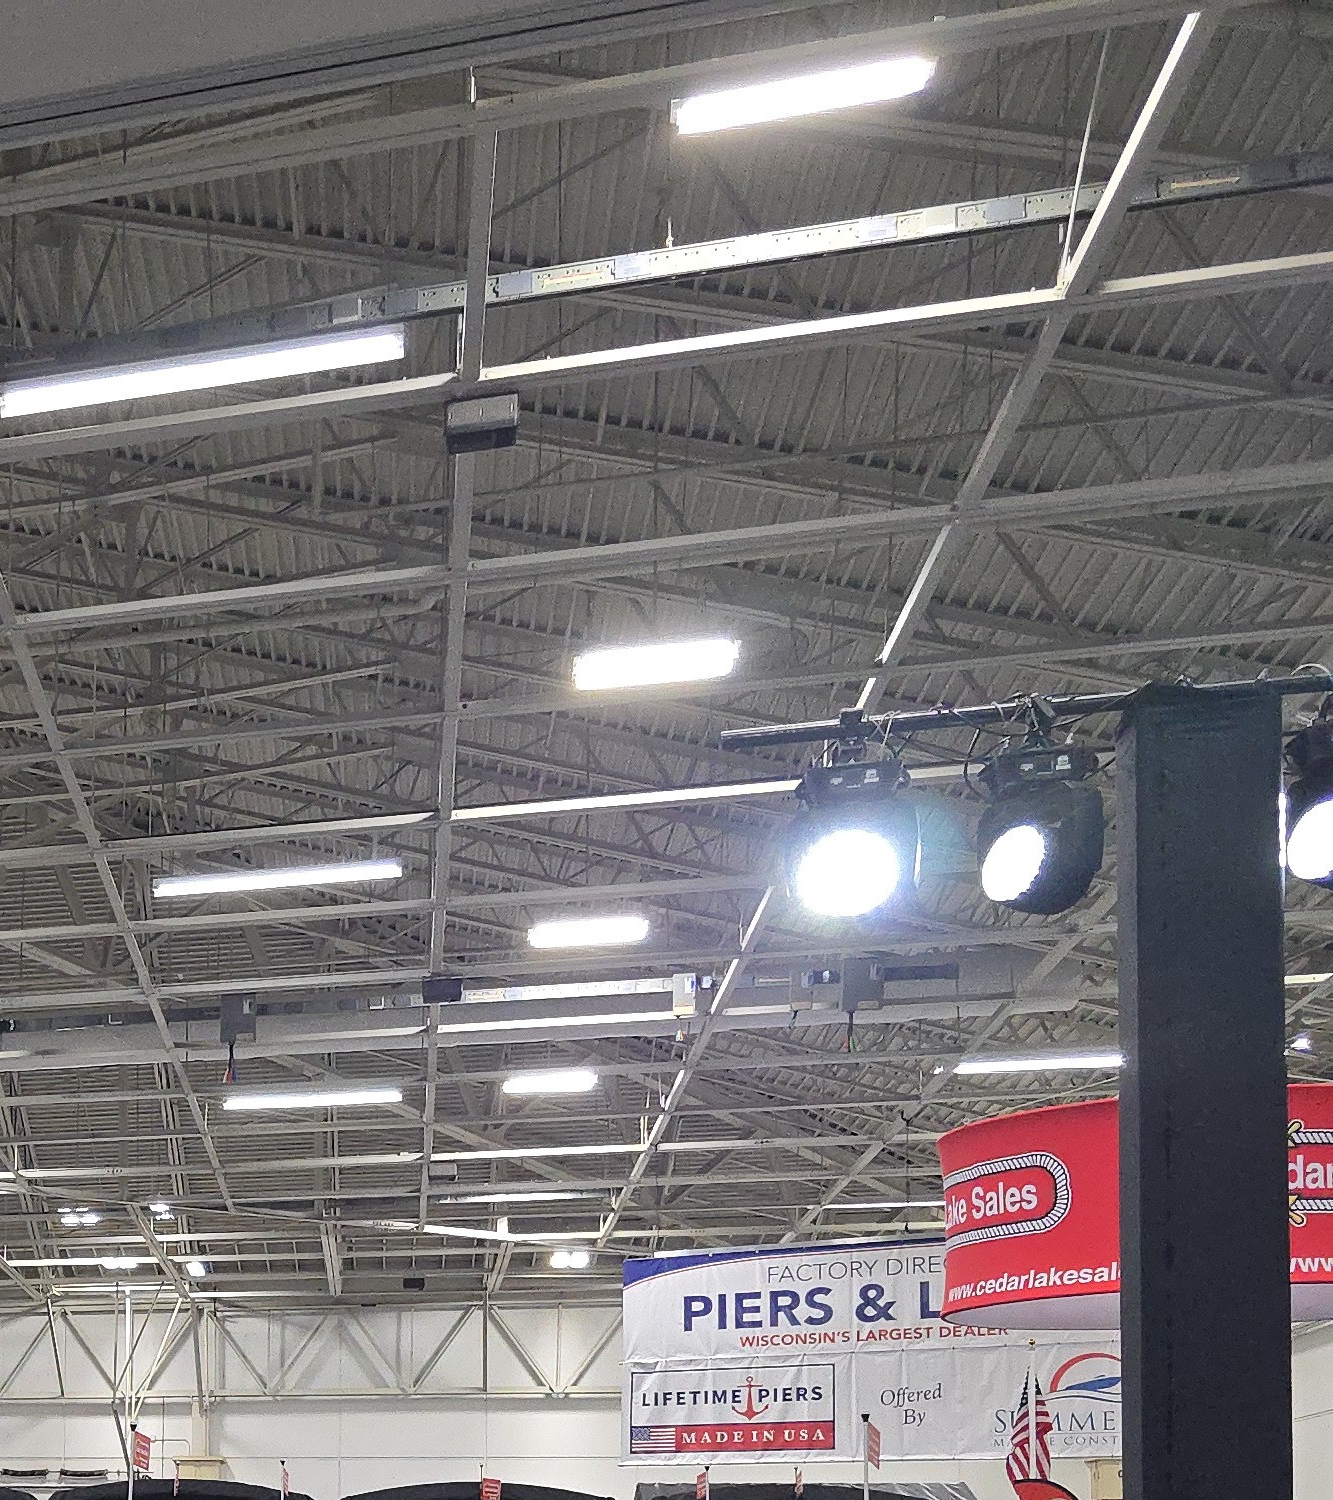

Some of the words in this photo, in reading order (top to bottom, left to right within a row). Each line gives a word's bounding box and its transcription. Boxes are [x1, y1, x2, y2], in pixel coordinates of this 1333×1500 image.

[971, 1181, 1038, 1219] Sales
[768, 1259, 879, 1284] FACTORY
[887, 1255, 946, 1276] DIRE
[948, 1262, 1121, 1303] www.cedarlakesal
[683, 1287, 834, 1333] PIERS
[855, 1283, 897, 1323] &
[740, 1330, 851, 1348] WISCONSIN'S
[856, 1327, 934, 1342] LARGEST
[939, 1325, 1009, 1338] DEALER
[642, 1389, 742, 1407] LIFETIME
[758, 1386, 823, 1404] PIERS
[880, 1382, 943, 1408] Offered
[902, 1408, 927, 1428] By
[682, 1430, 744, 1445] MADE
[752, 1429, 775, 1442] IN
[784, 1428, 826, 1442] USA
